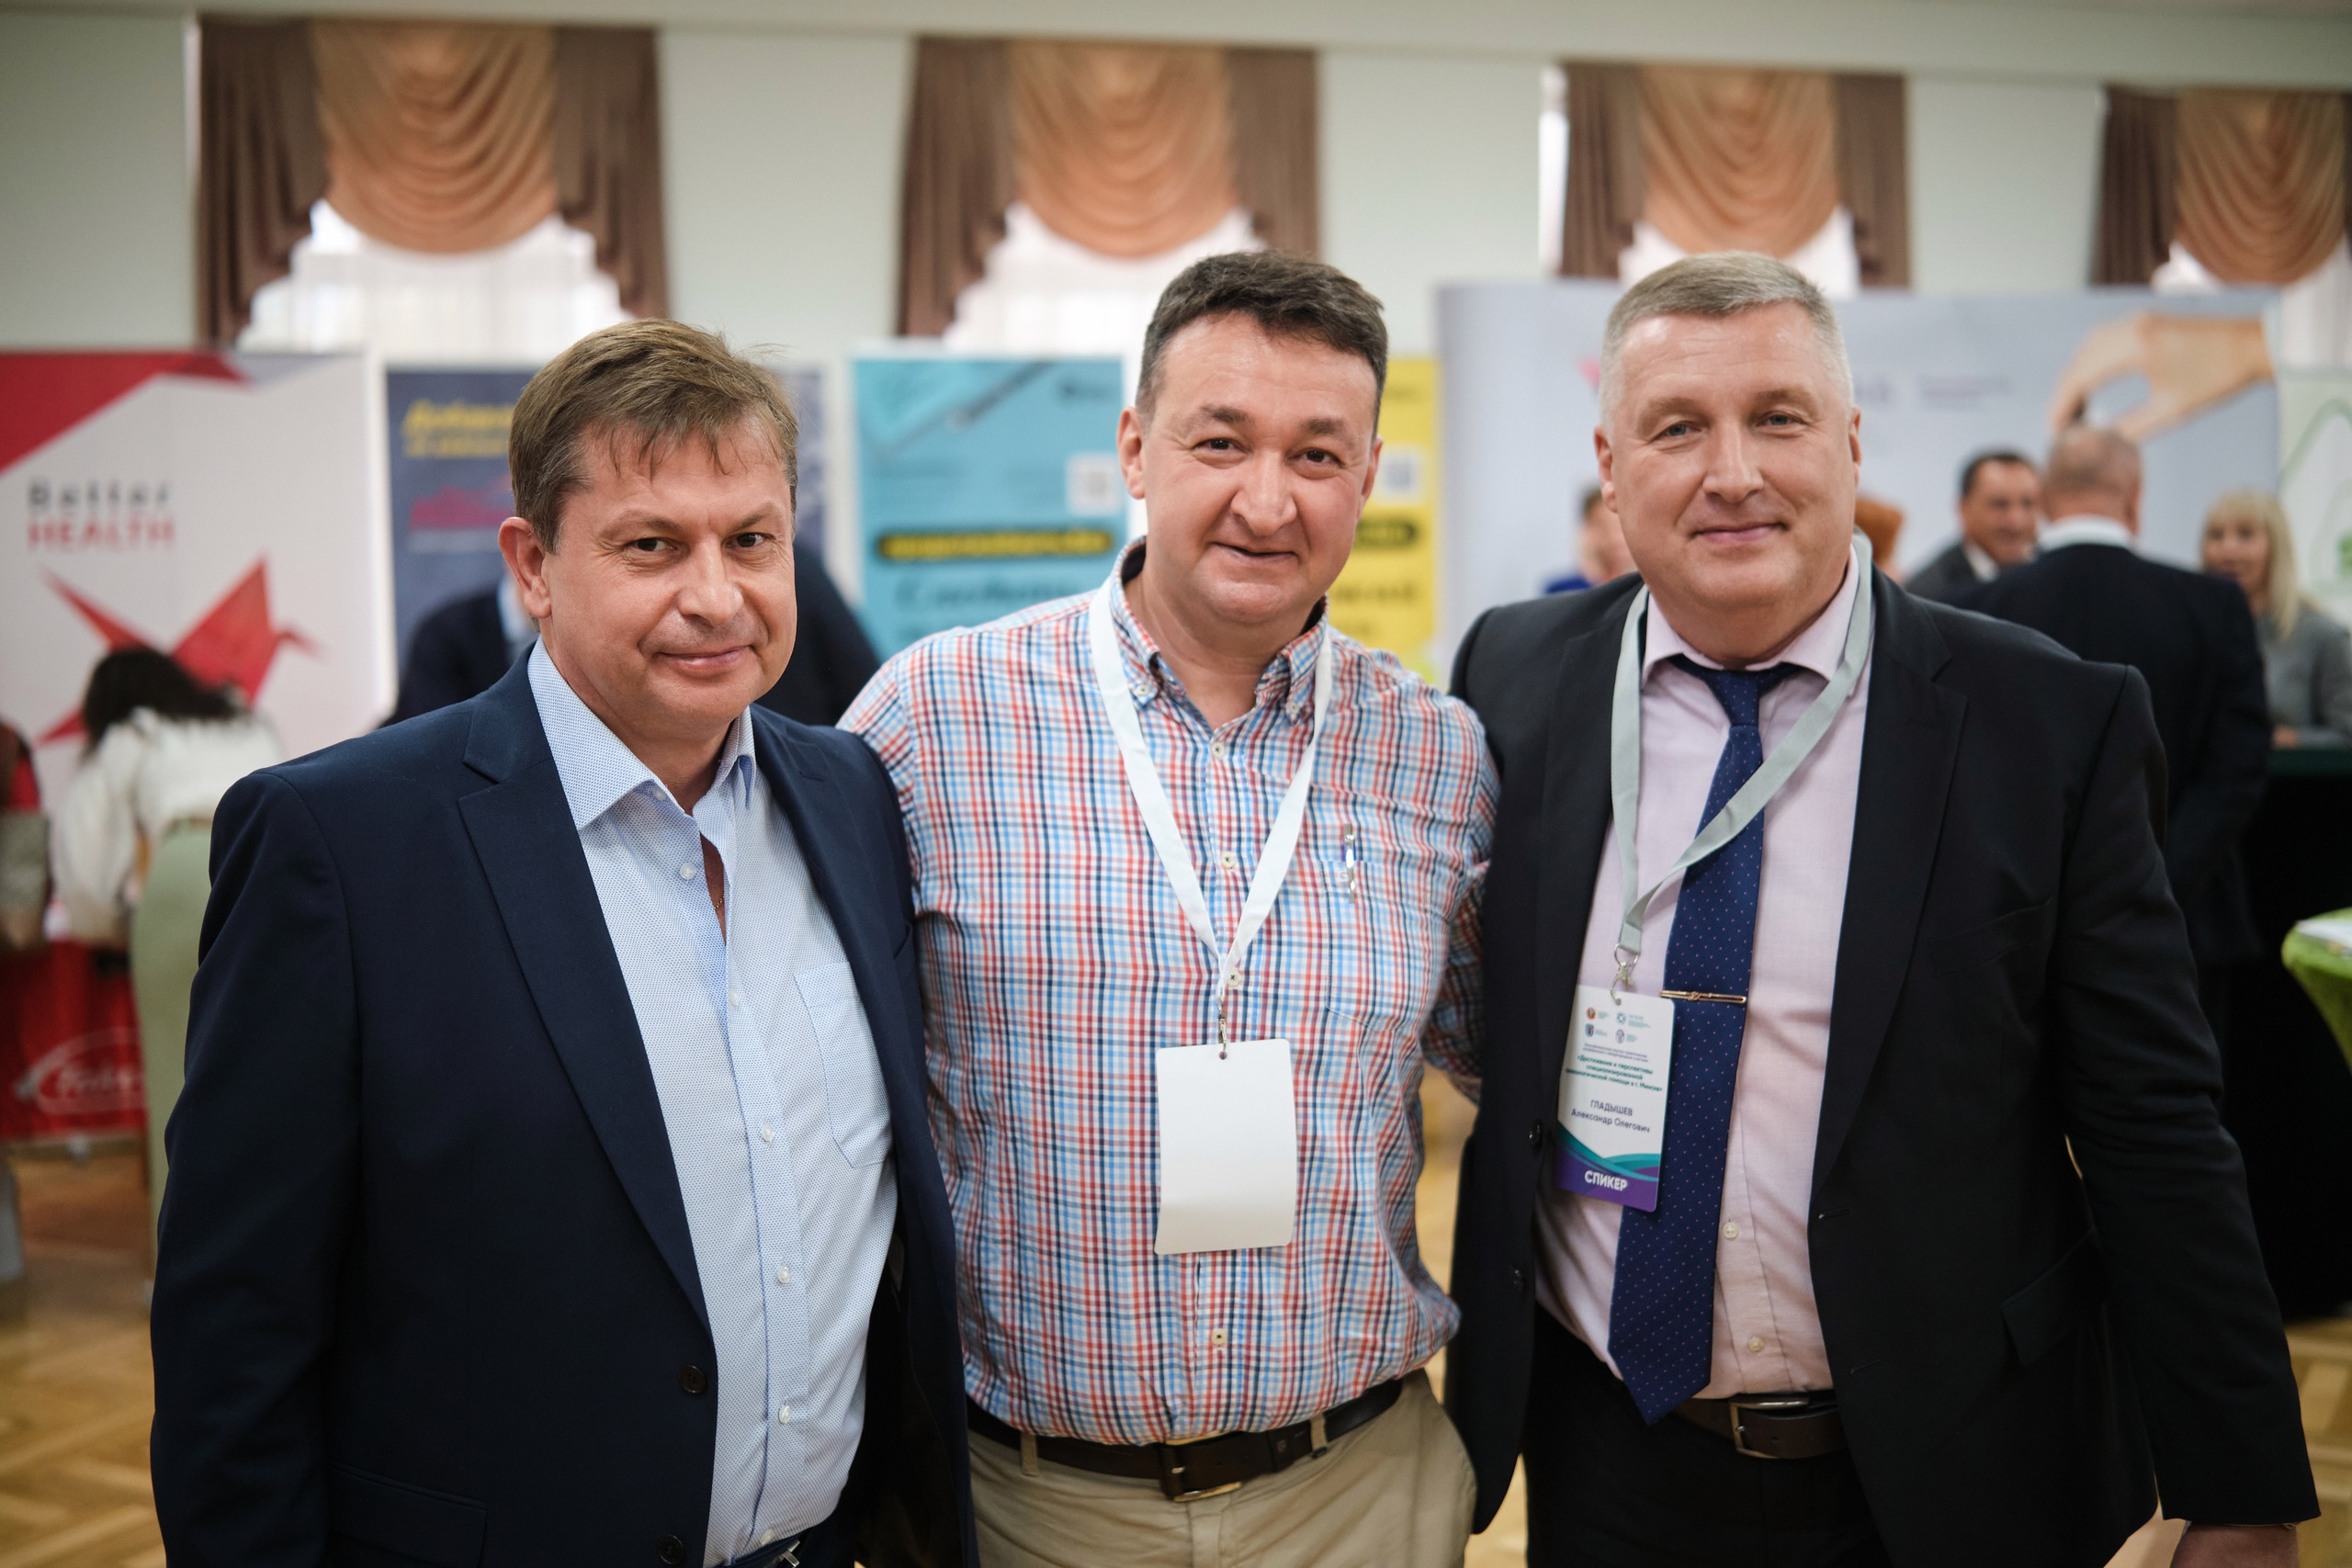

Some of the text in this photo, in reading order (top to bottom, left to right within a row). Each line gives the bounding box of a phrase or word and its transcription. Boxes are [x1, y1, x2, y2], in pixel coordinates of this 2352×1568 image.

[27, 515, 175, 550] HEALTH
[1618, 1062, 1654, 1075] перспективы
[1608, 1076, 1630, 1086] помощи
[1589, 1100, 1634, 1117] ГЛАДЫШЕВ
[1570, 1108, 1650, 1134] Александр Олегович
[1584, 1169, 1628, 1192] СПИКЕР
